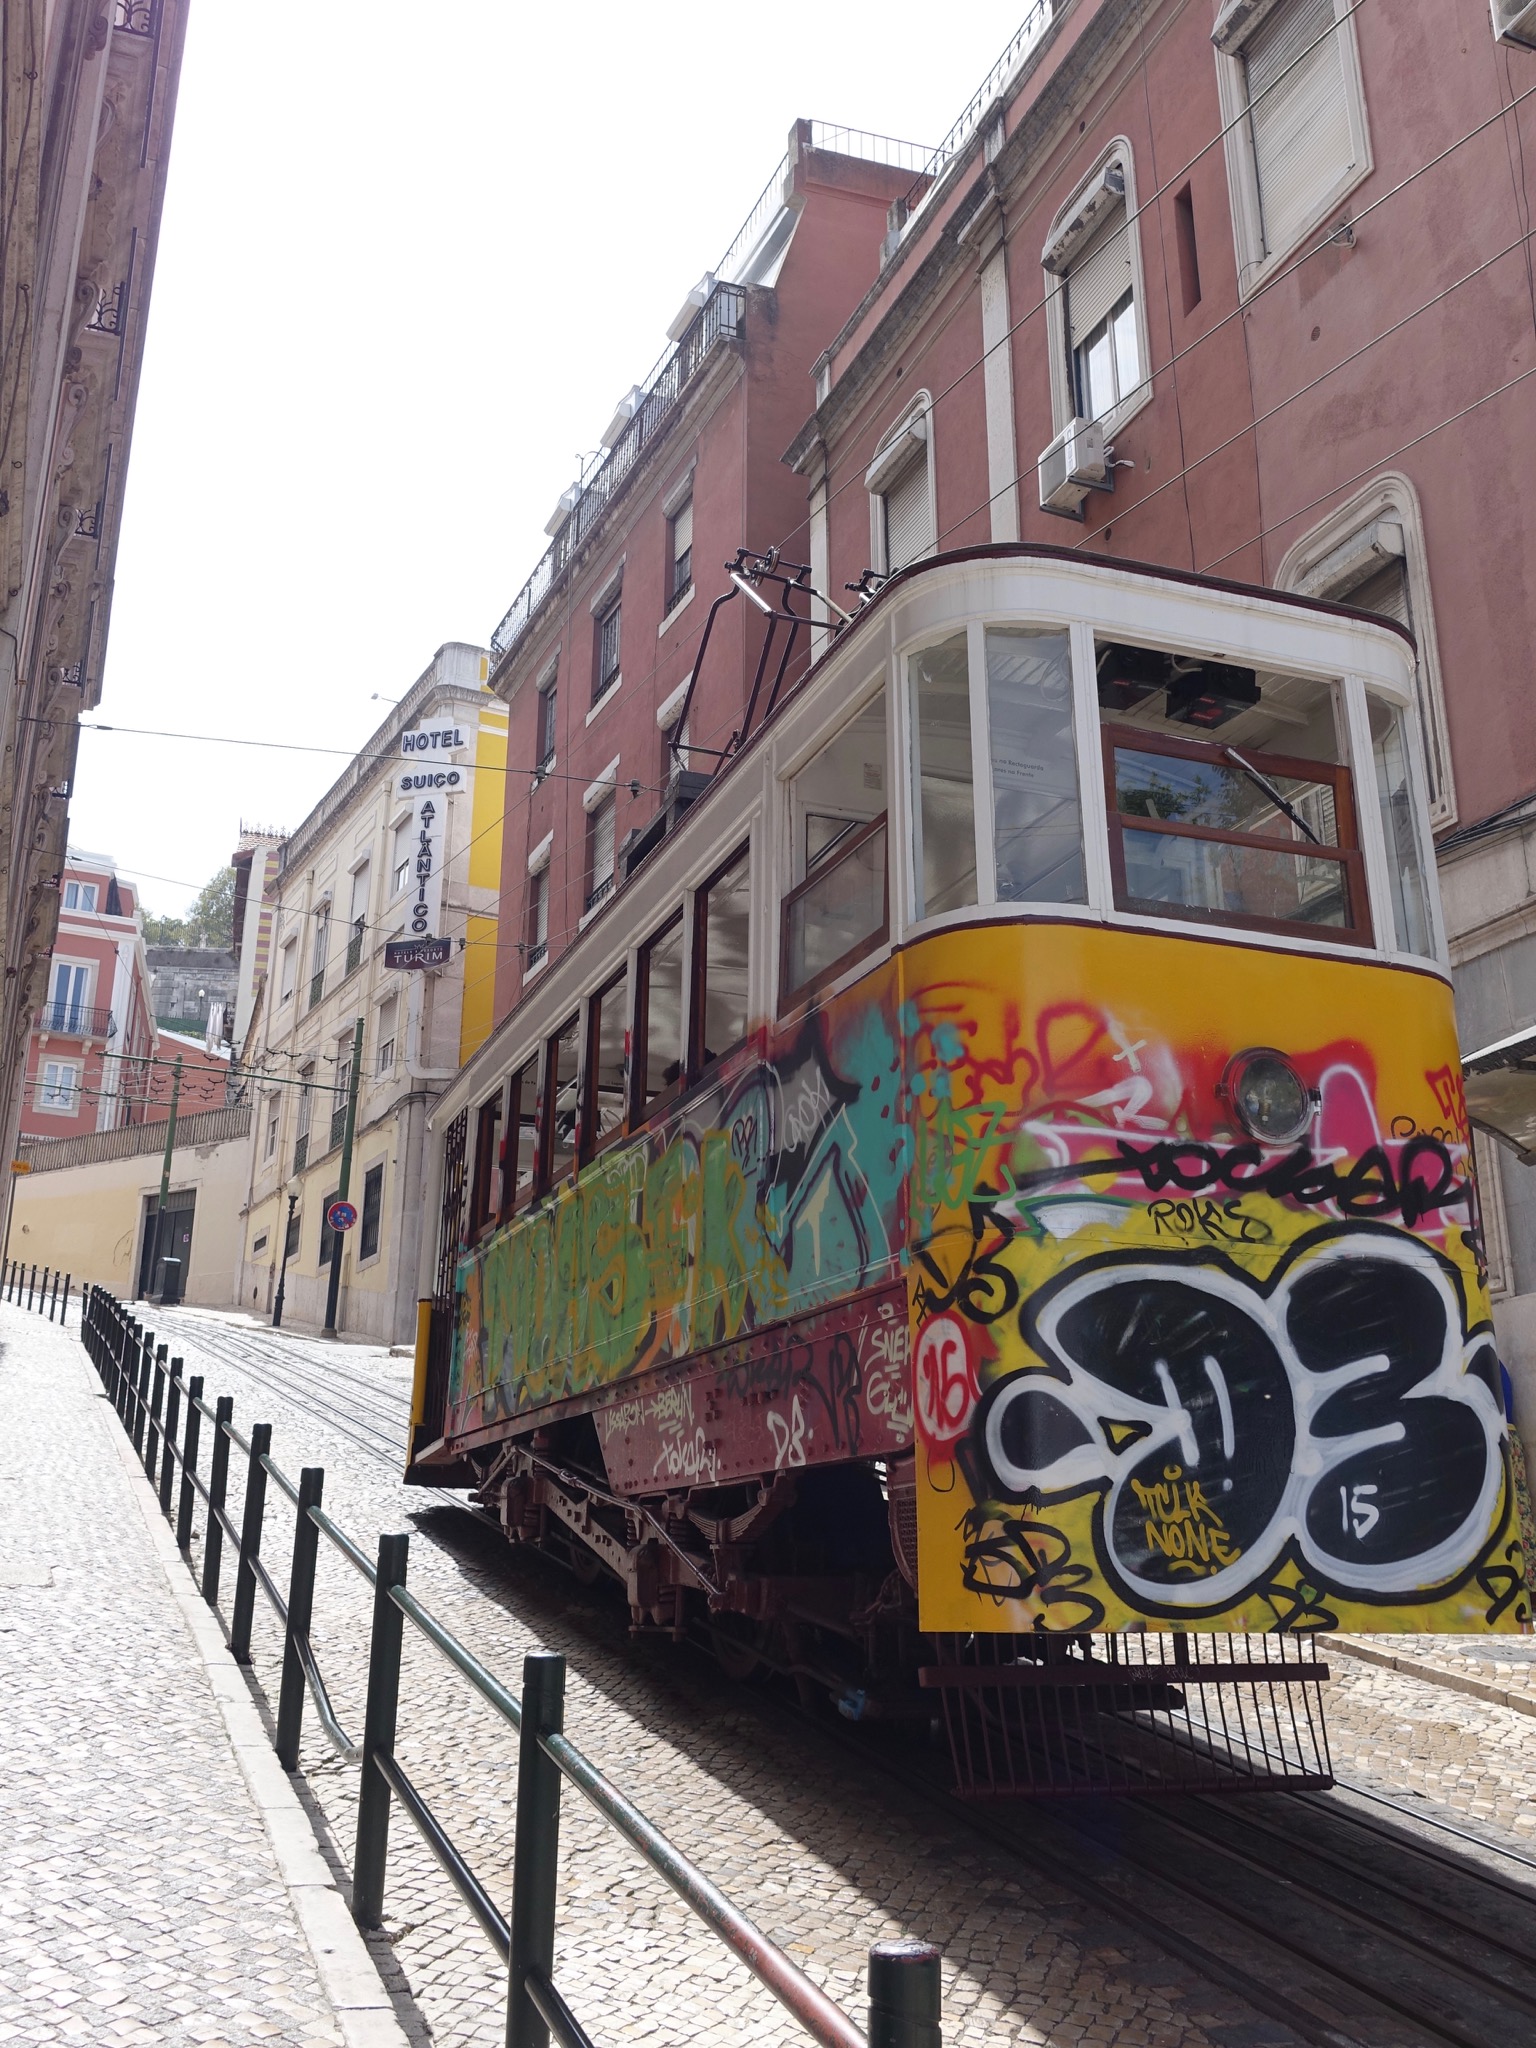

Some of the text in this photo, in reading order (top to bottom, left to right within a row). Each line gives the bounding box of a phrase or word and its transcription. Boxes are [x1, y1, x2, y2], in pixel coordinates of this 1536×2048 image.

[403, 729, 464, 752] HOTEL
[401, 771, 460, 790] SUIÇO
[412, 801, 435, 932] ATLÂNTICO
[394, 951, 443, 964] TURIM
[1340, 1484, 1380, 1539] 15
[1145, 1520, 1241, 1566] NONE
